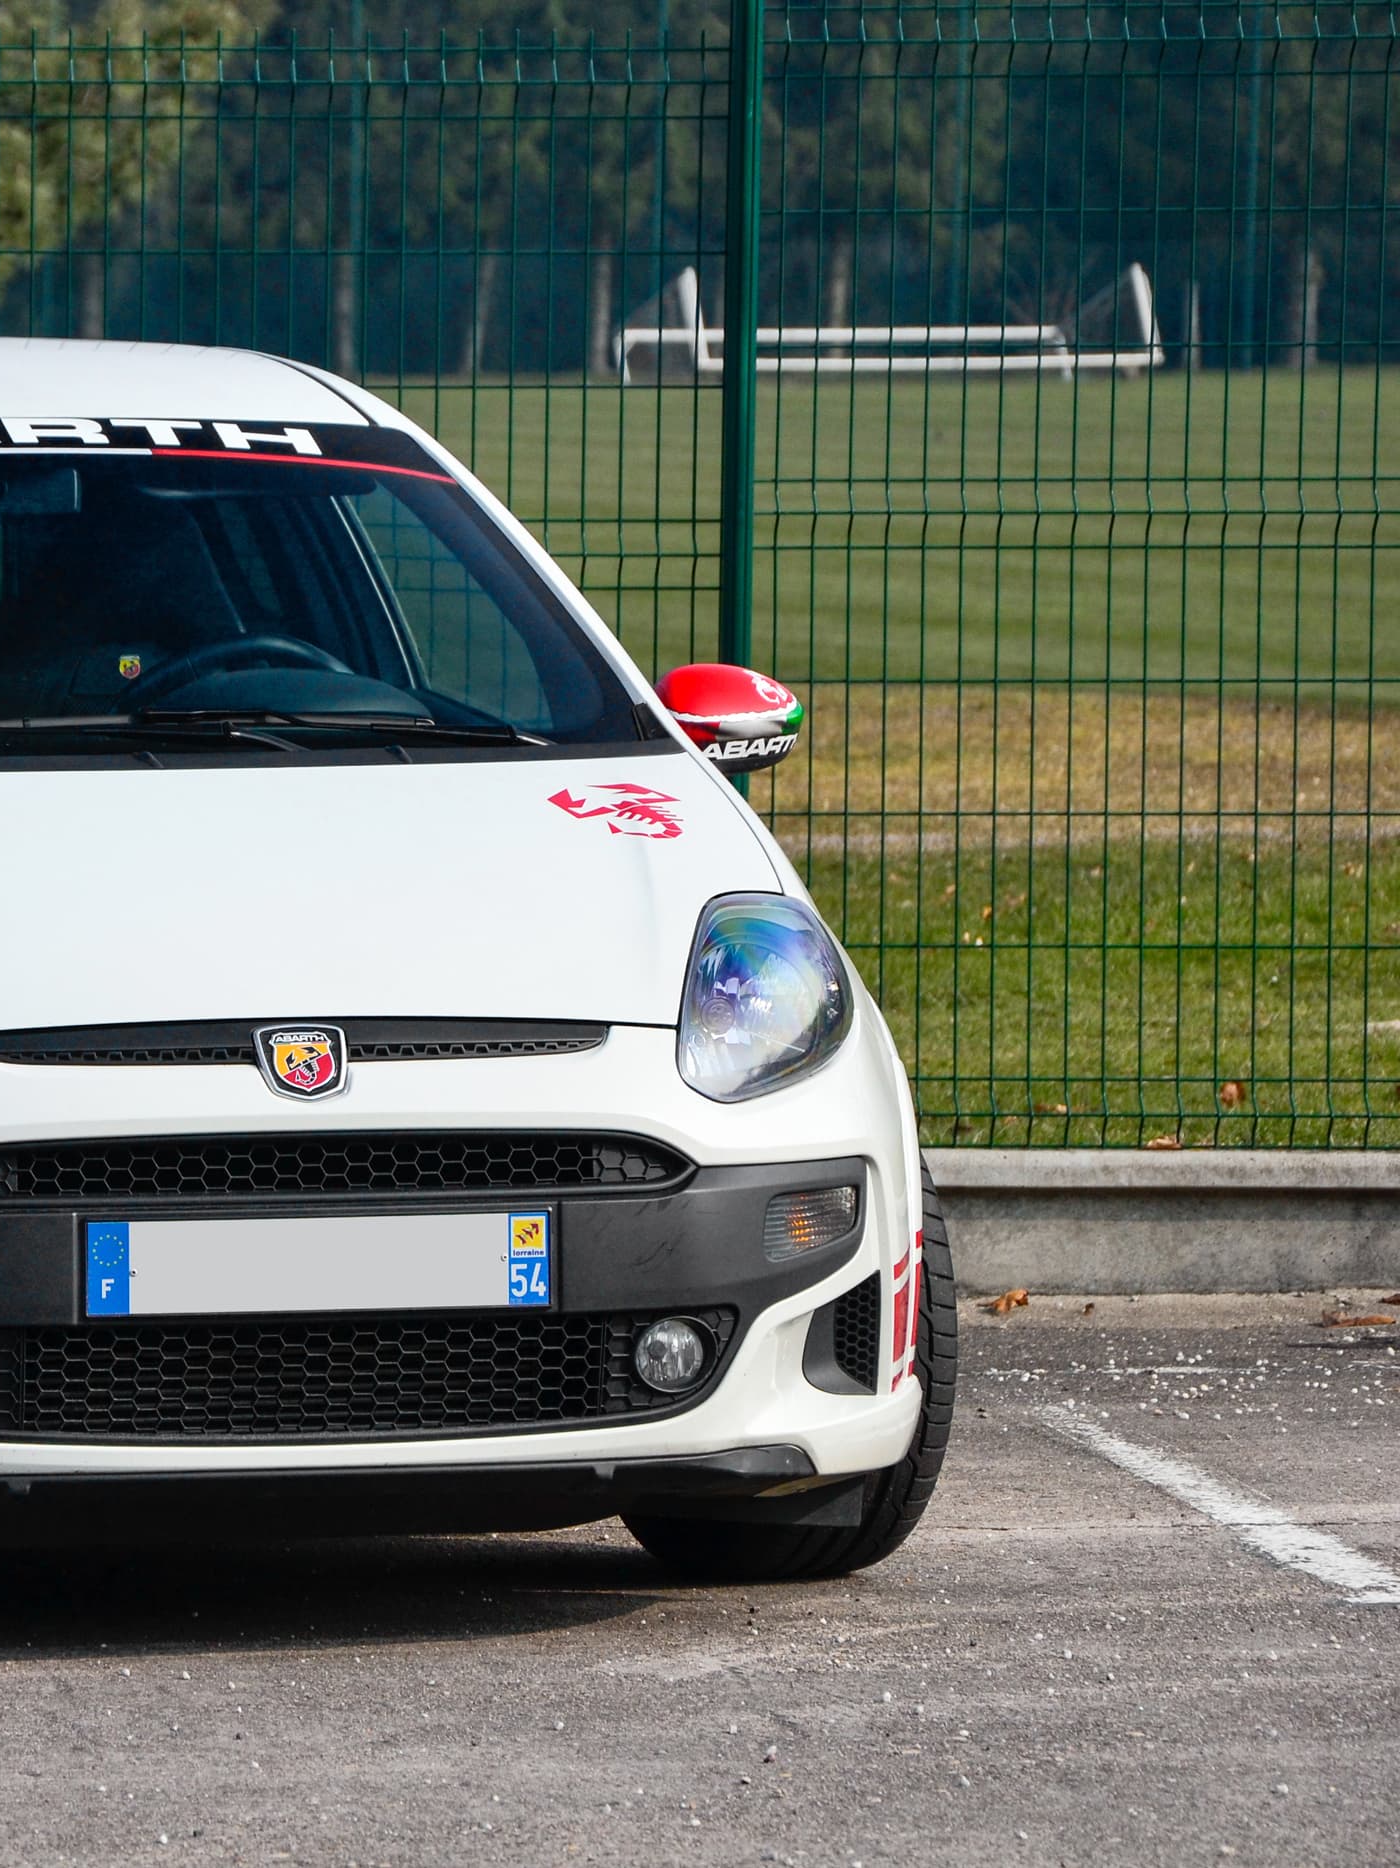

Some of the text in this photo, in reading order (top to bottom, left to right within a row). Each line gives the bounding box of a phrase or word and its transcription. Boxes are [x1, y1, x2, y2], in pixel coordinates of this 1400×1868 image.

[701, 733, 798, 760] ABART
[275, 1034, 325, 1043] ABARTH
[512, 1249, 545, 1257] lorraine
[101, 1278, 115, 1299] F
[510, 1262, 546, 1297] 54
